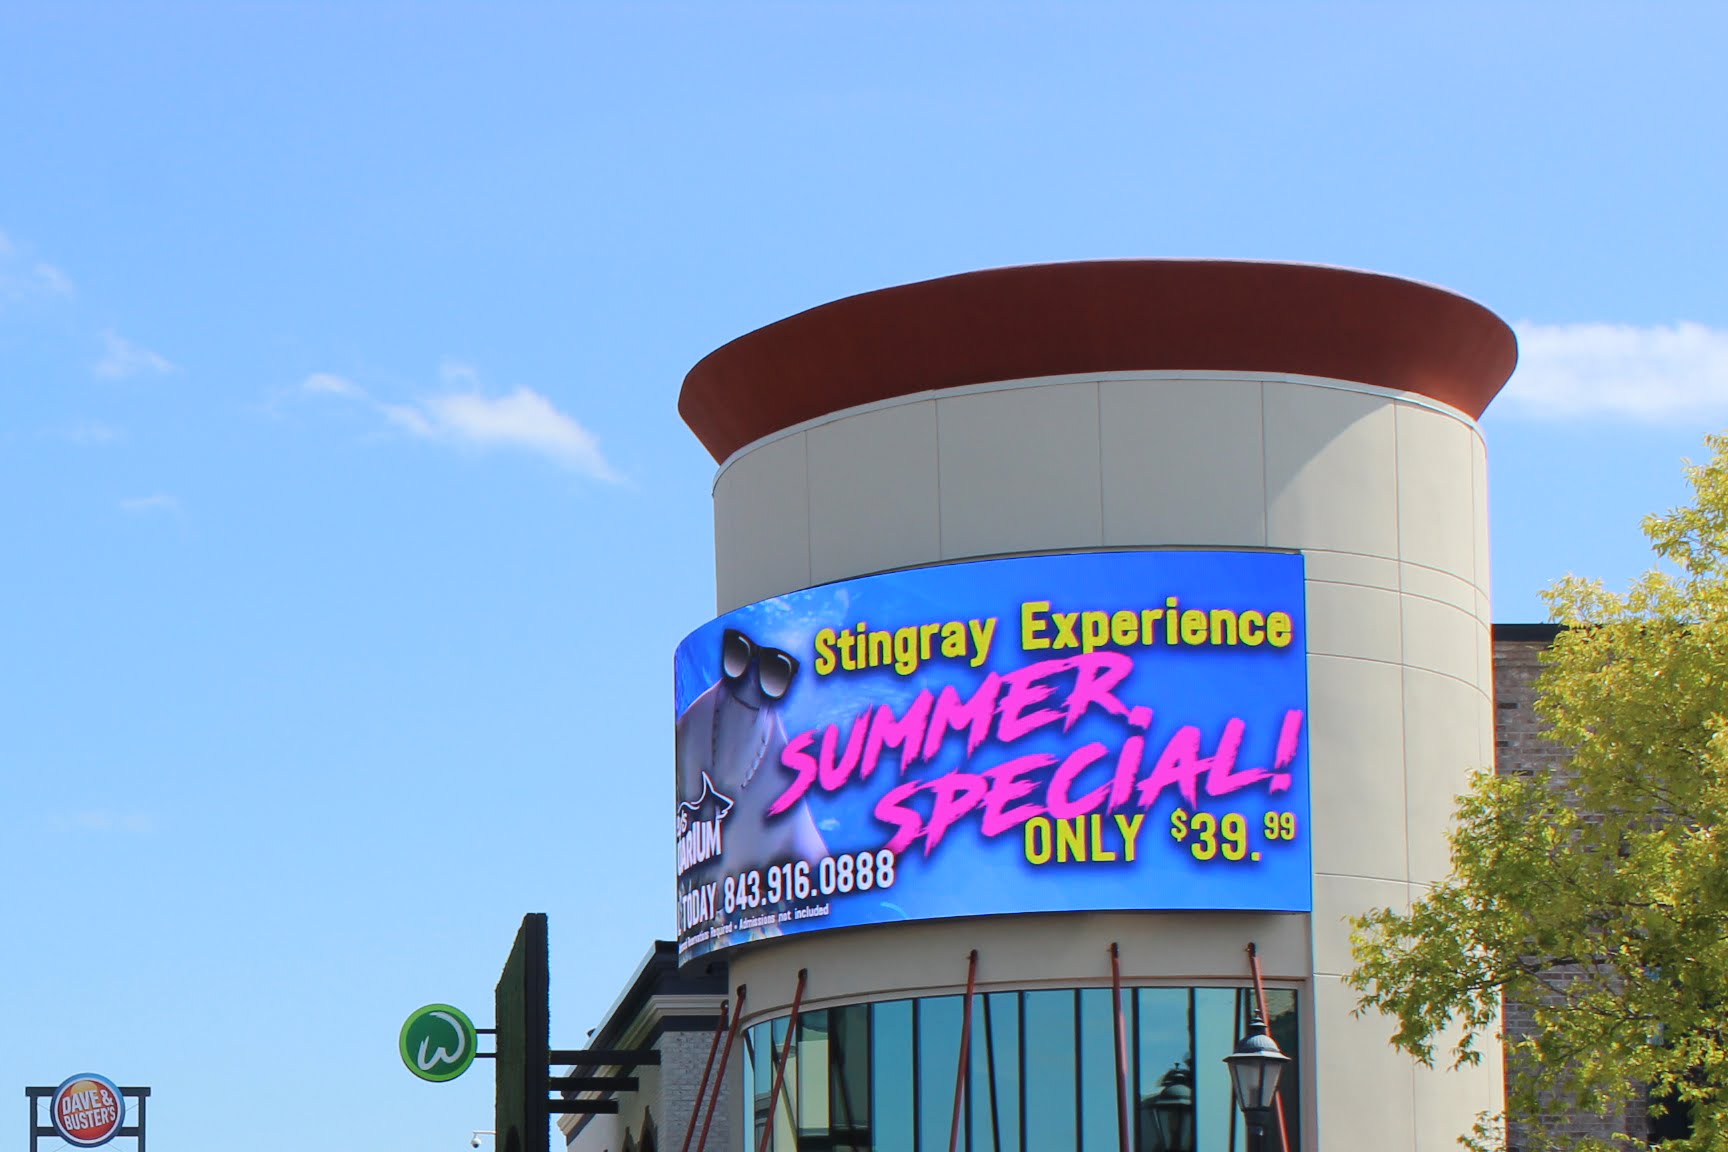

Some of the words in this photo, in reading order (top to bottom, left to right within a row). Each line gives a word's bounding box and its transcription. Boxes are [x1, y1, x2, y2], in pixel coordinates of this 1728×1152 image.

[815, 616, 996, 676] Stingray
[1021, 597, 1293, 655] Experience
[875, 709, 1303, 857] SPECIAL!
[1024, 813, 1146, 864] ONLY
[682, 883, 717, 932] TODAY
[724, 849, 895, 915] 843.916.0888
[739, 914, 776, 930] Admissions
[778, 910, 792, 922] not
[794, 903, 830, 919] included
[62, 1089, 102, 1116] DAVE
[99, 1088, 115, 1107] &
[63, 1105, 117, 1131] BUSTER'S
